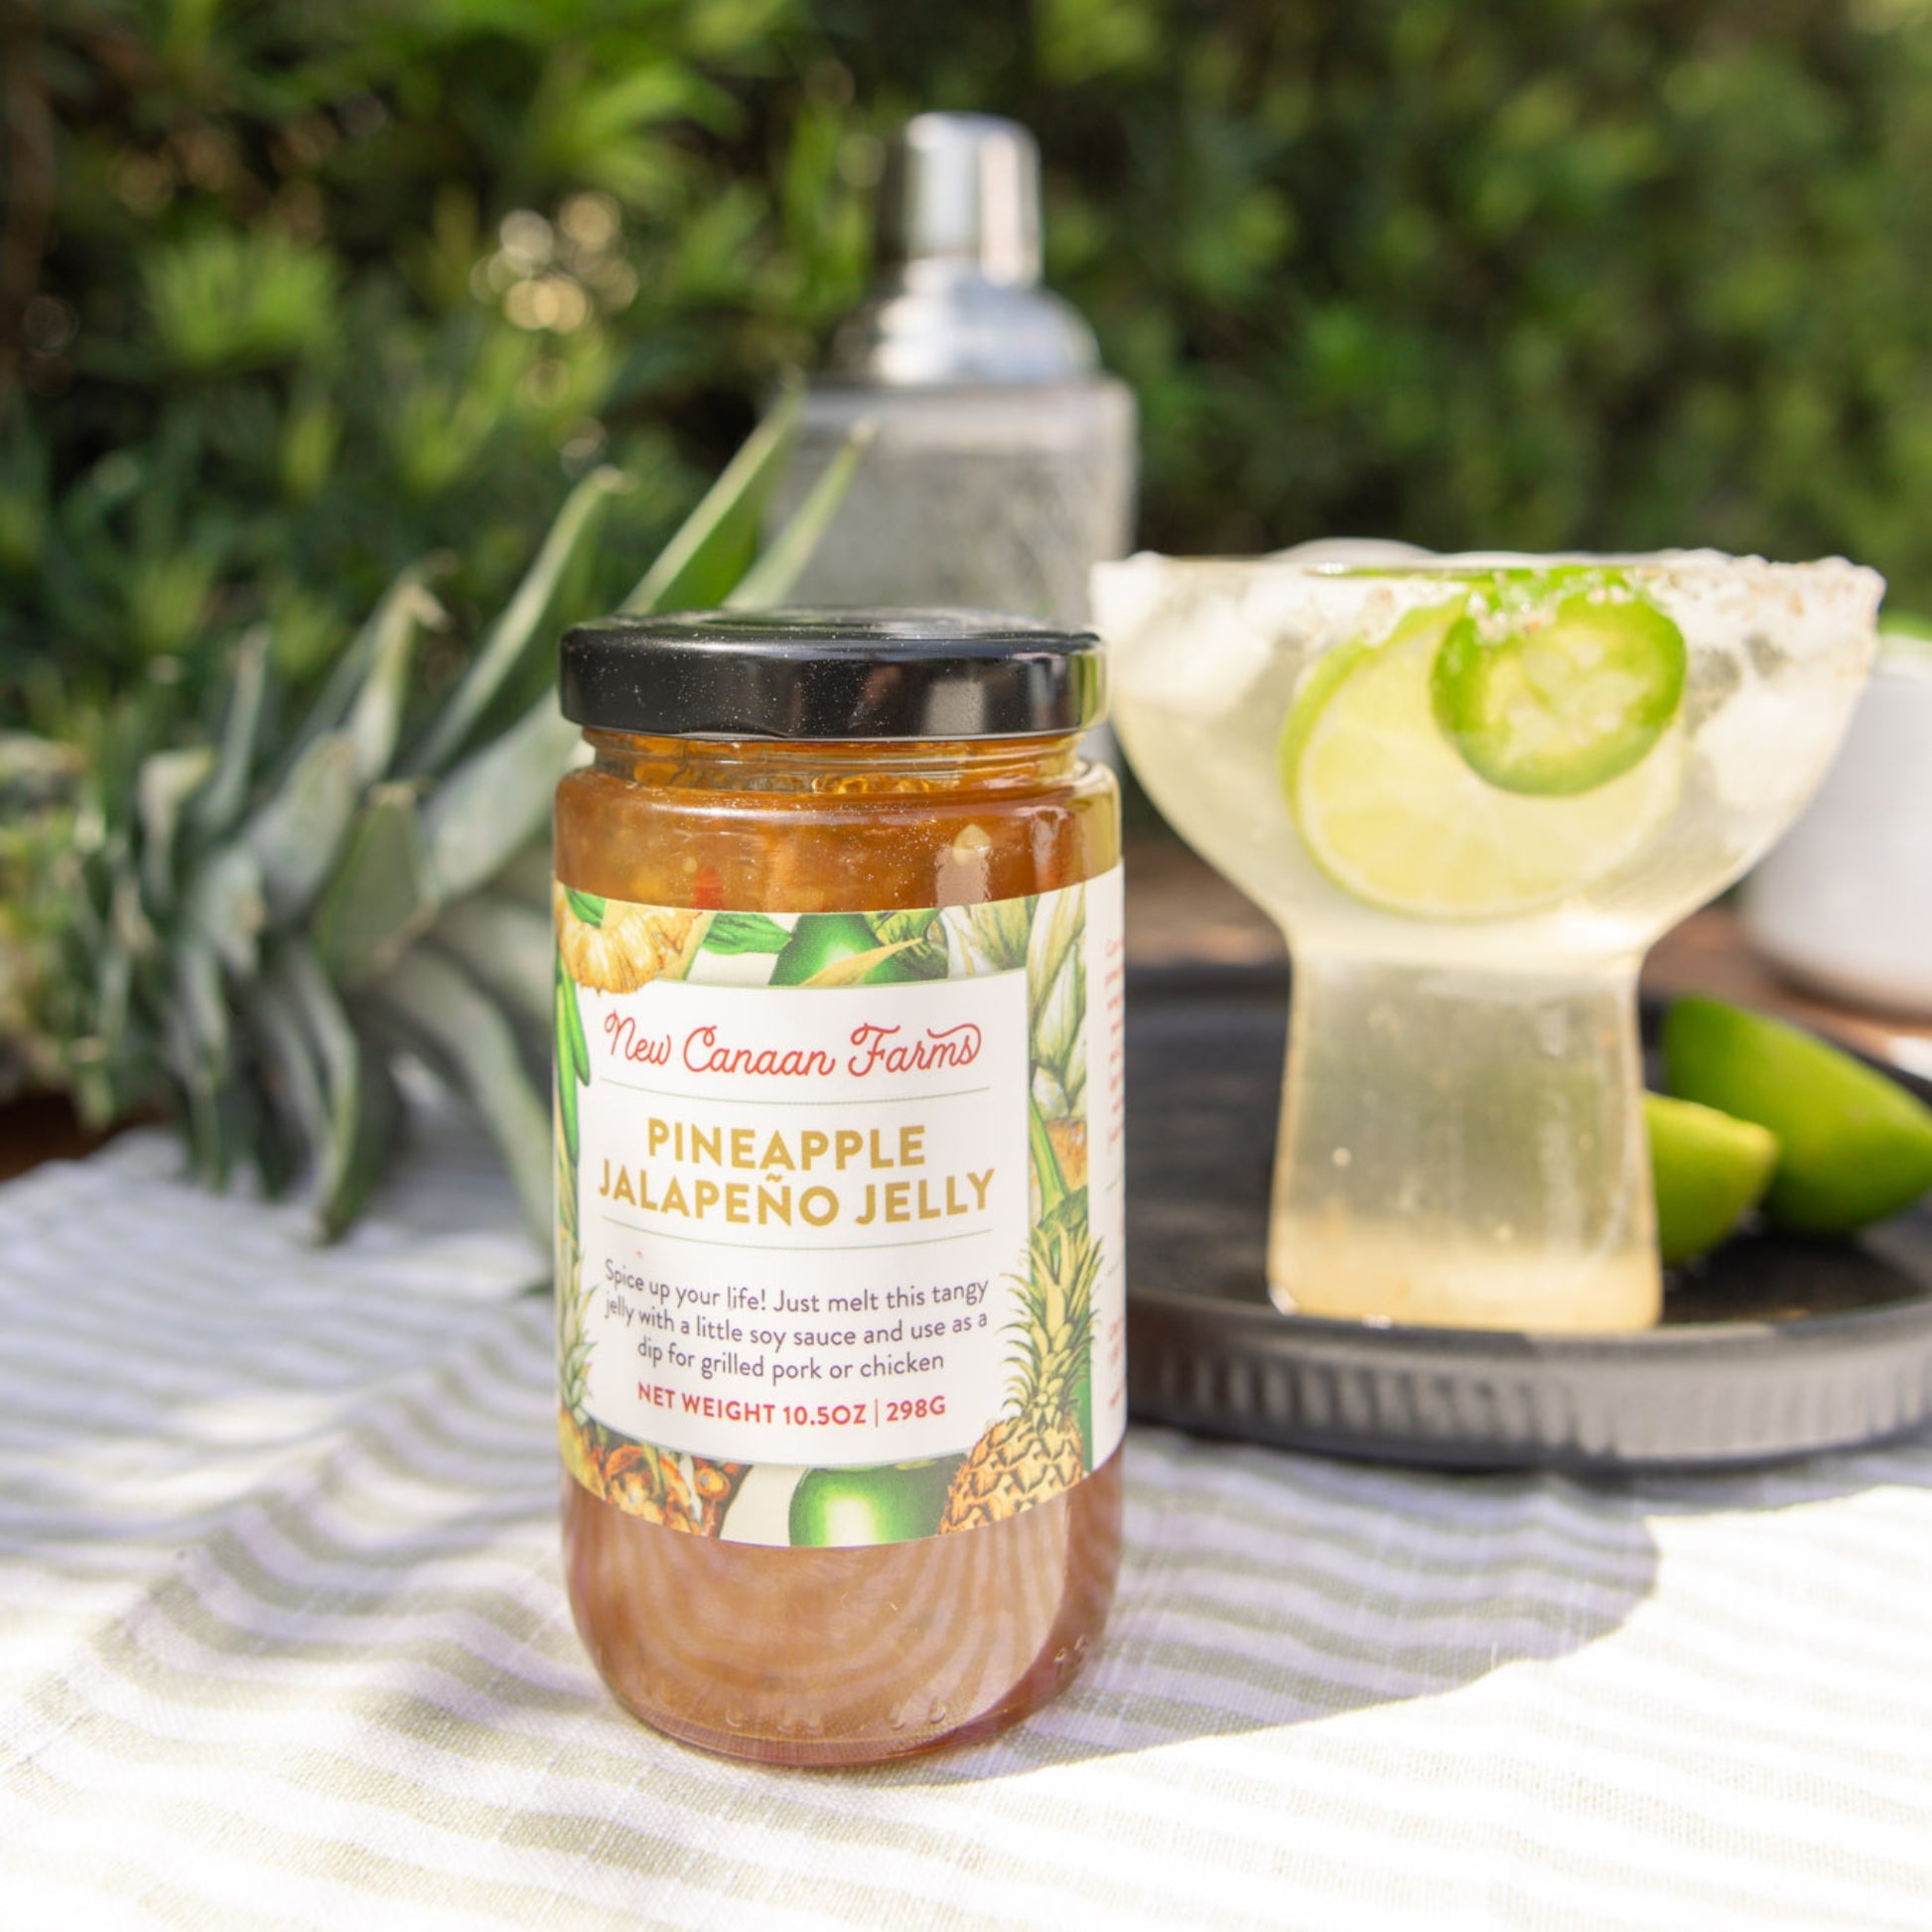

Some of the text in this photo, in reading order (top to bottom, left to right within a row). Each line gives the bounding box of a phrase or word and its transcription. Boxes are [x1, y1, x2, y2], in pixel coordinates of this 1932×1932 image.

[604, 1009, 983, 1079] New Canaan Farms
[647, 1117, 926, 1173] PINEAPPLE
[598, 1159, 996, 1228] JALAPEÑO JELLY
[605, 1258, 989, 1312] Spice up your life! Just melt this tangy
[604, 1291, 989, 1353] jelly with a little soy sauce and use as a
[637, 1334, 944, 1387] dip for grilled pork or chicken
[638, 1380, 947, 1427] NET WEIGHT 10.5OZ 298G
